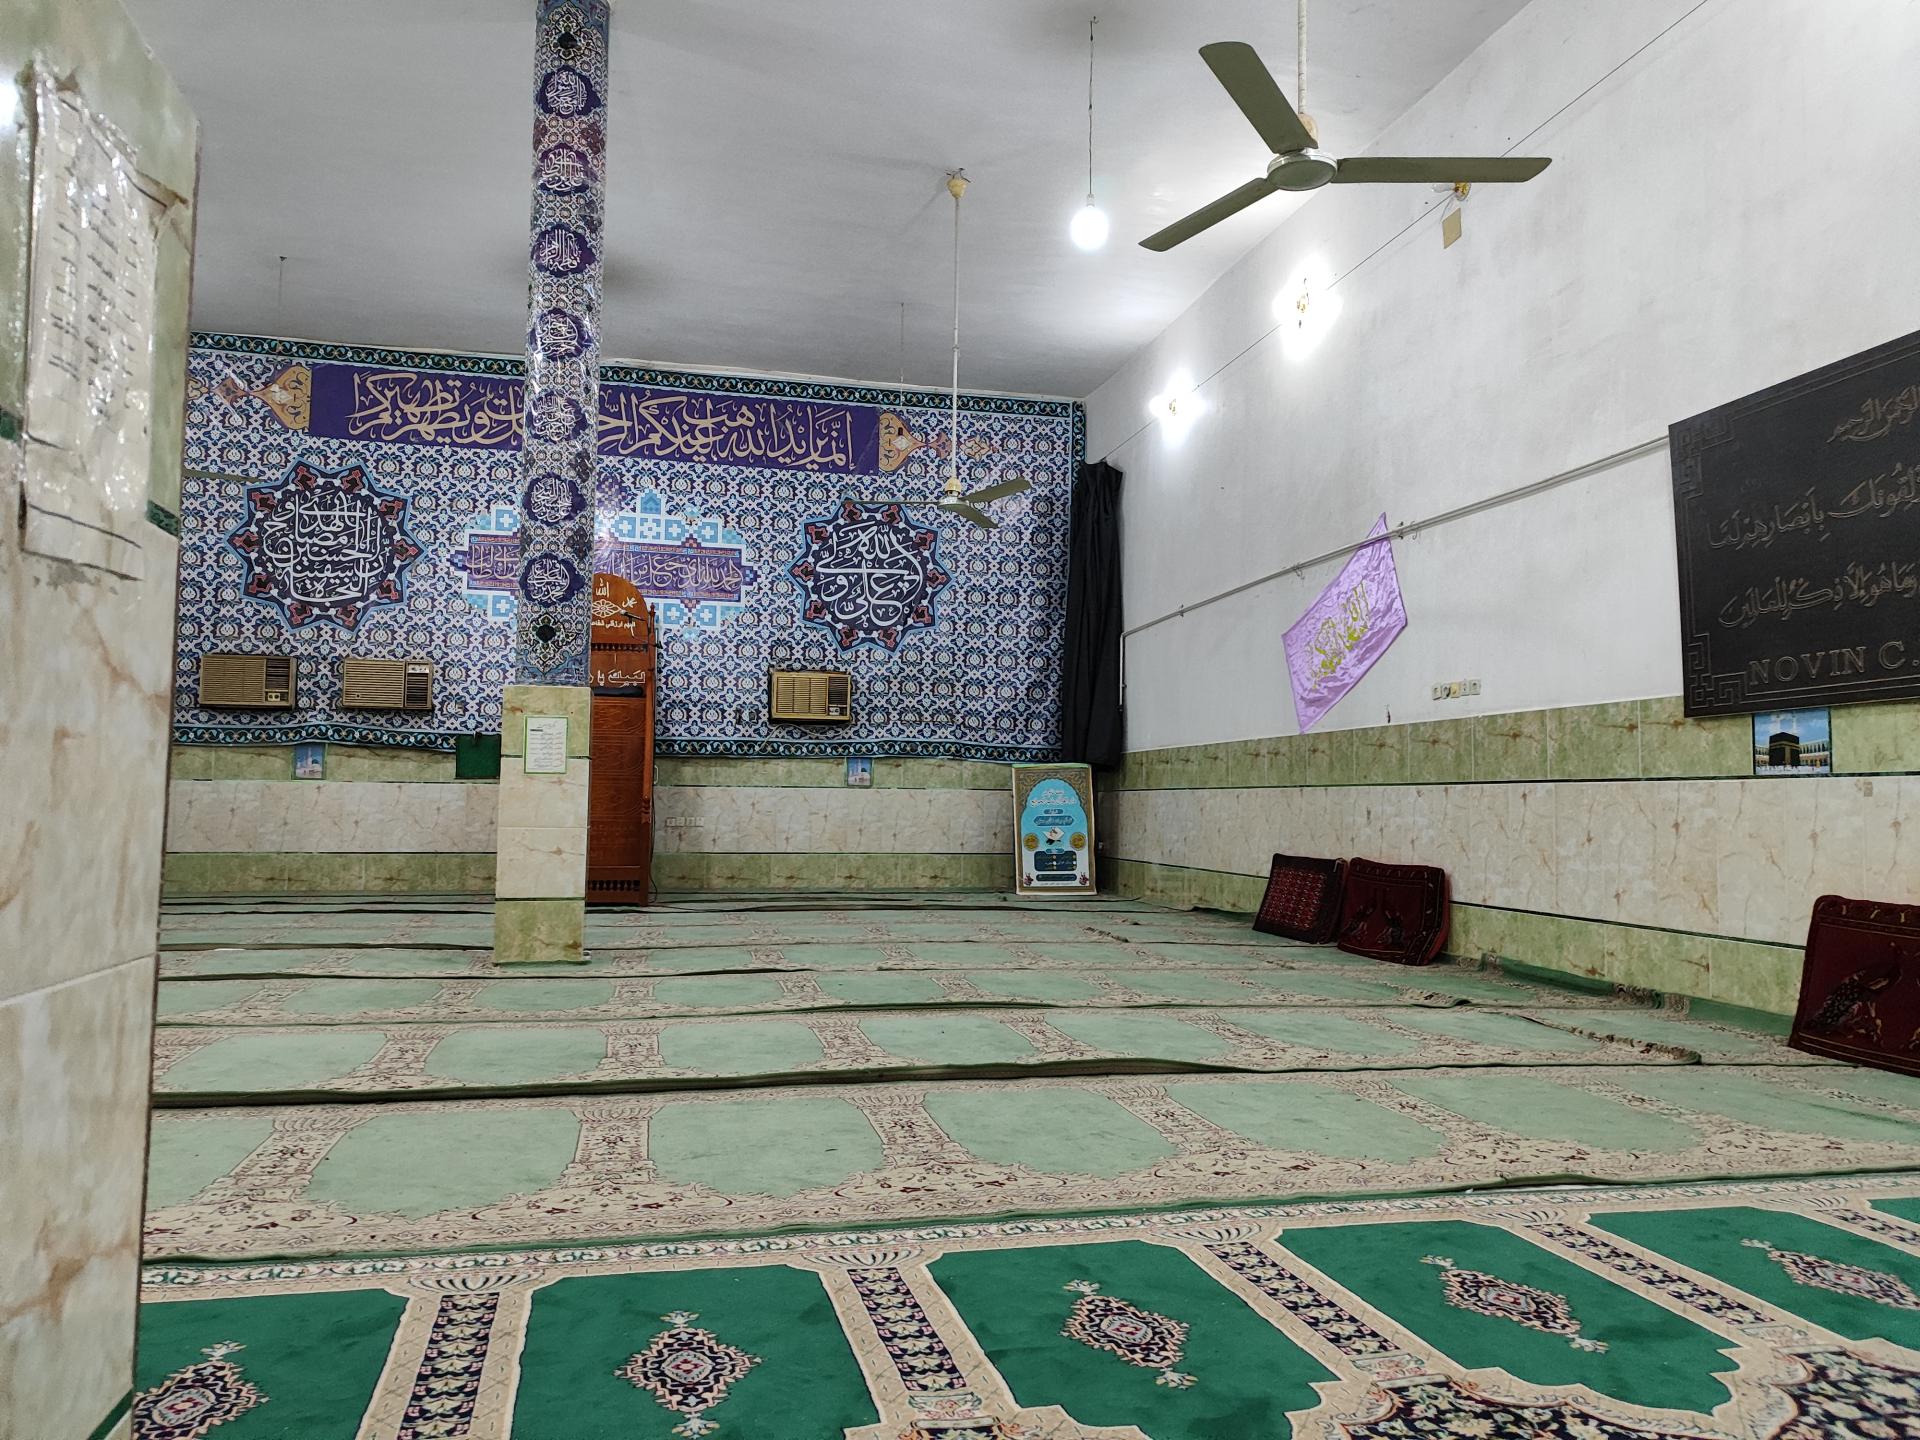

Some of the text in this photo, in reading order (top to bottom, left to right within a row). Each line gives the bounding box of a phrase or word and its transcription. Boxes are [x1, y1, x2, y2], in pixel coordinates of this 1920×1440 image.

[595, 577, 609, 598] الله
[1748, 645, 1868, 686] NOVIN
[597, 670, 605, 687] يا
